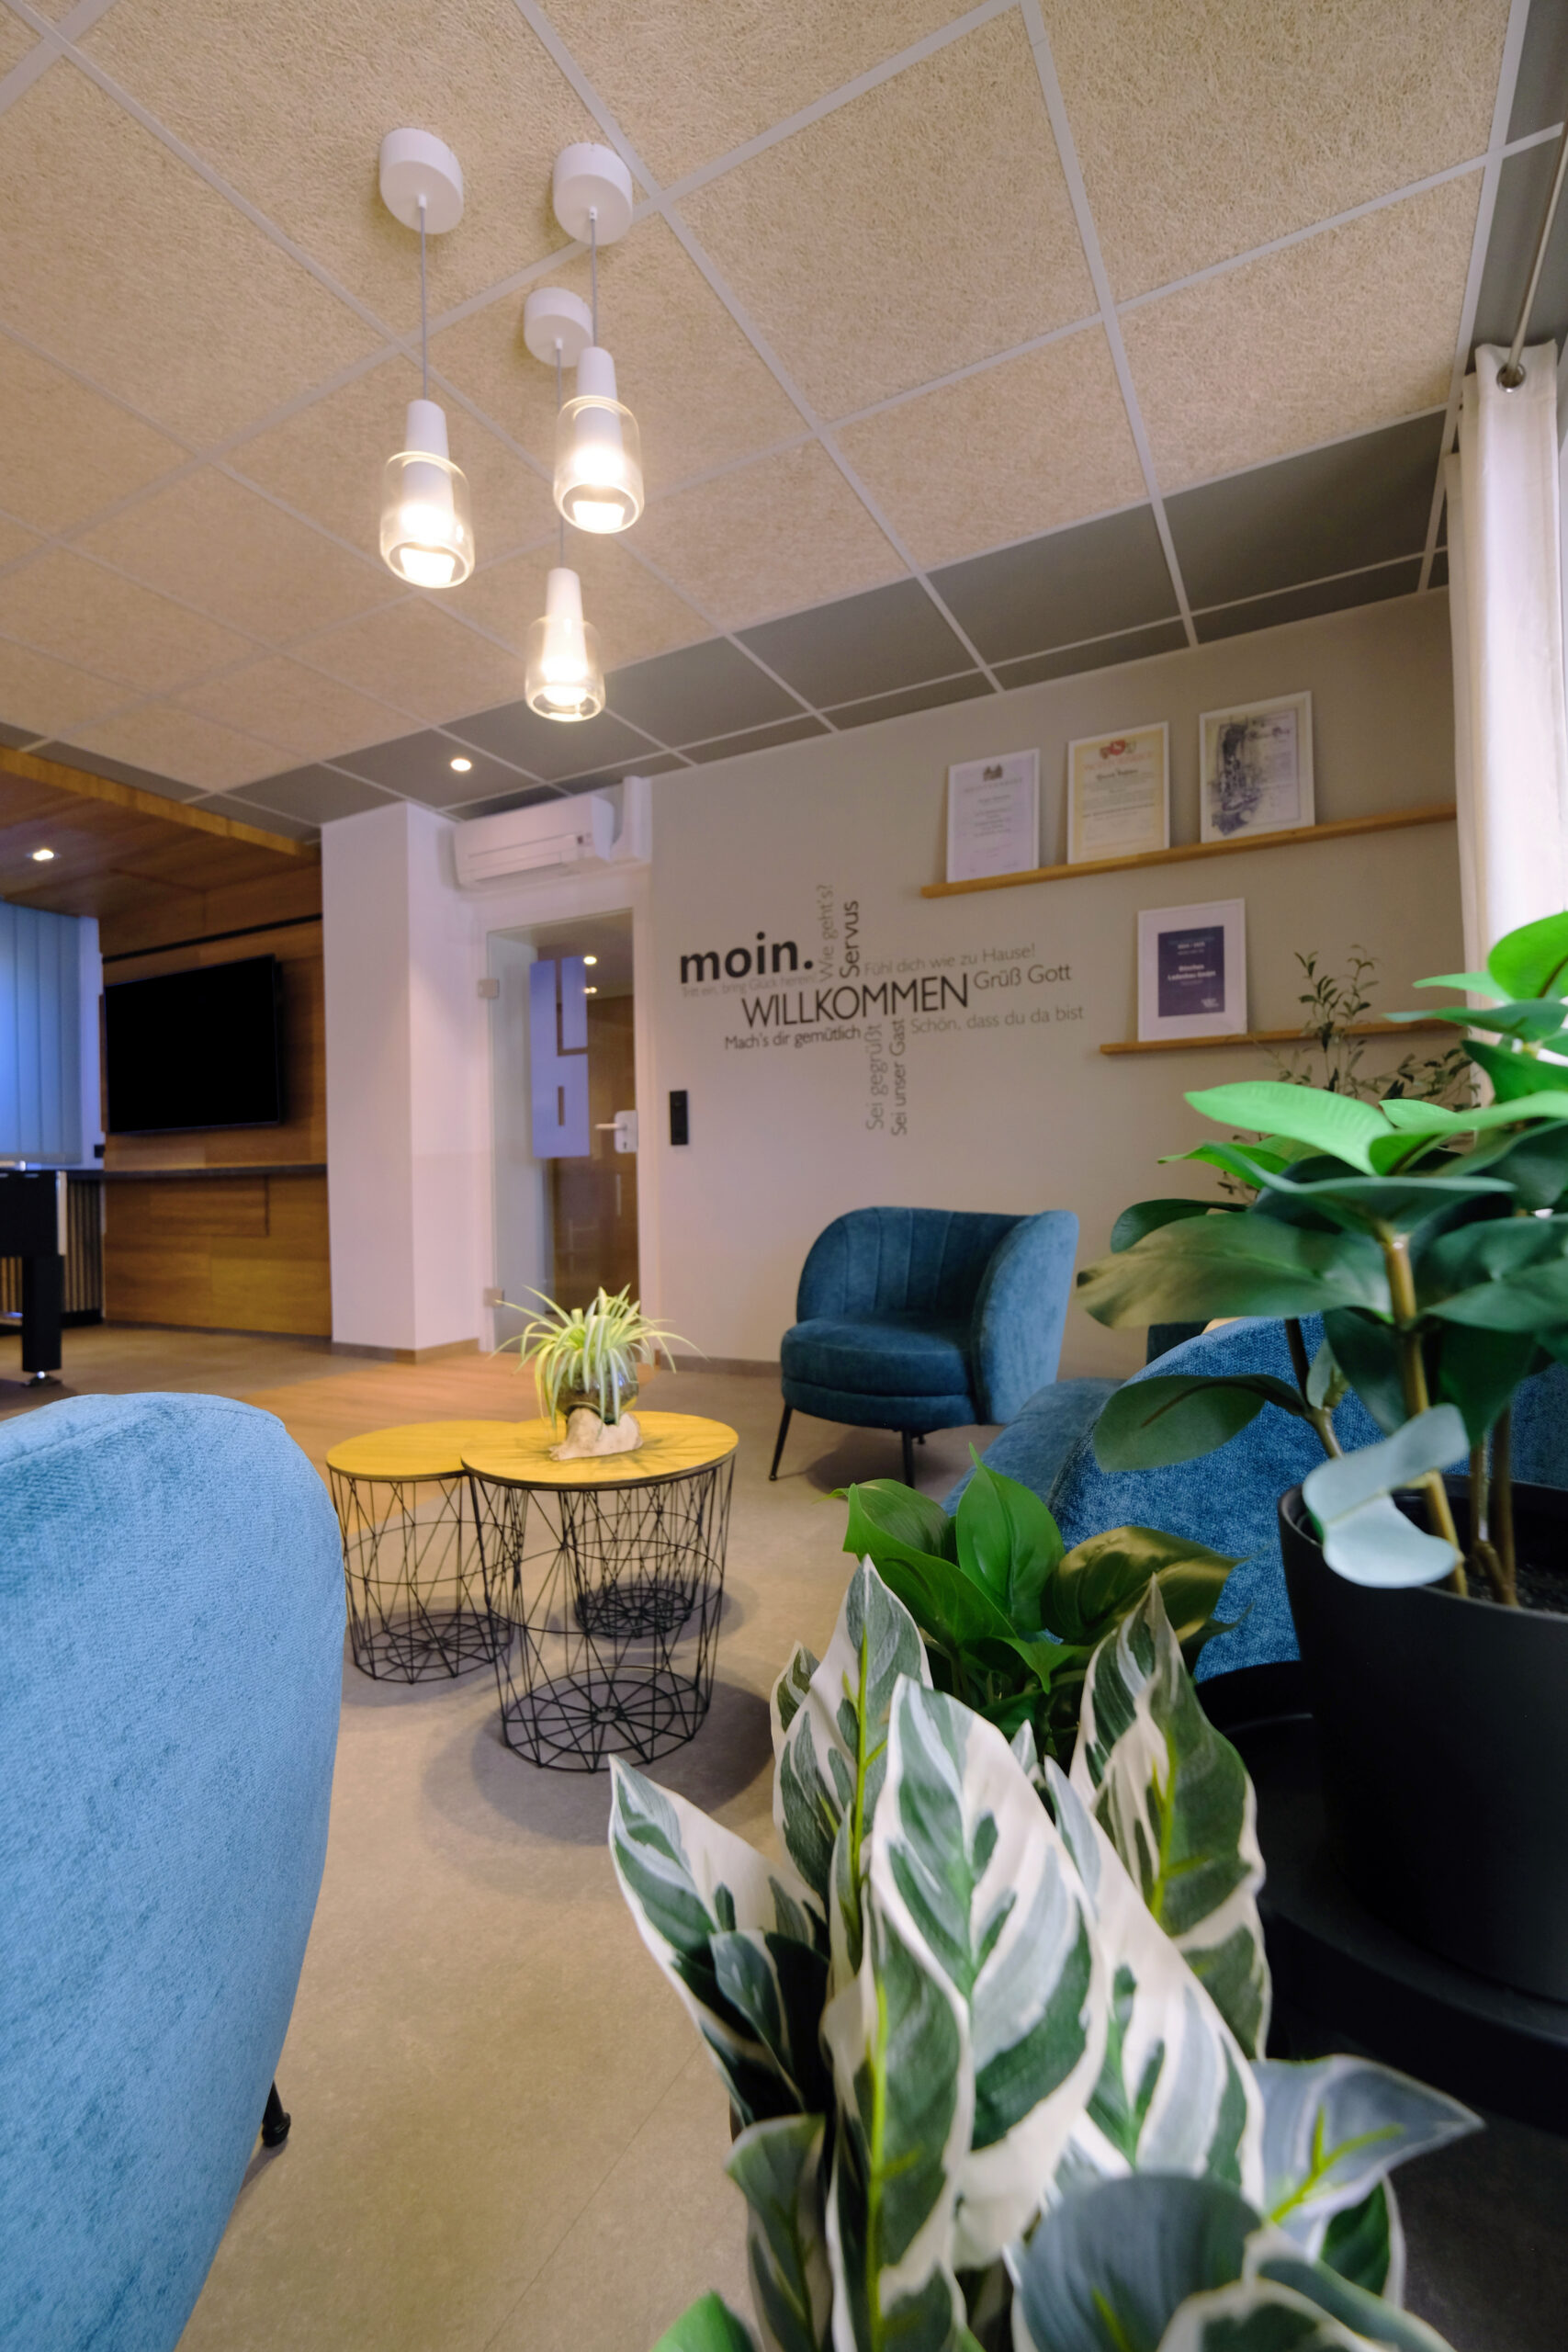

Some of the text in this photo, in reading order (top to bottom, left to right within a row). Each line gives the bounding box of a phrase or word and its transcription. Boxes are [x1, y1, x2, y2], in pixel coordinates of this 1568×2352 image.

[680, 931, 814, 984] moin.
[840, 900, 860, 978] Servus
[864, 943, 1035, 976] Fühl dich wie zu Hause!
[818, 945, 833, 982] Wie
[974, 964, 1071, 989] Grüß Gott
[741, 972, 968, 1028] WILLKOMMEN
[910, 1005, 1084, 1035] Schön, dass du da bist
[725, 1023, 862, 1050] Mach's dir gemütlich
[863, 1023, 888, 1130] Sei gegrüßt
[889, 1018, 908, 1136] Sei unser Gast
